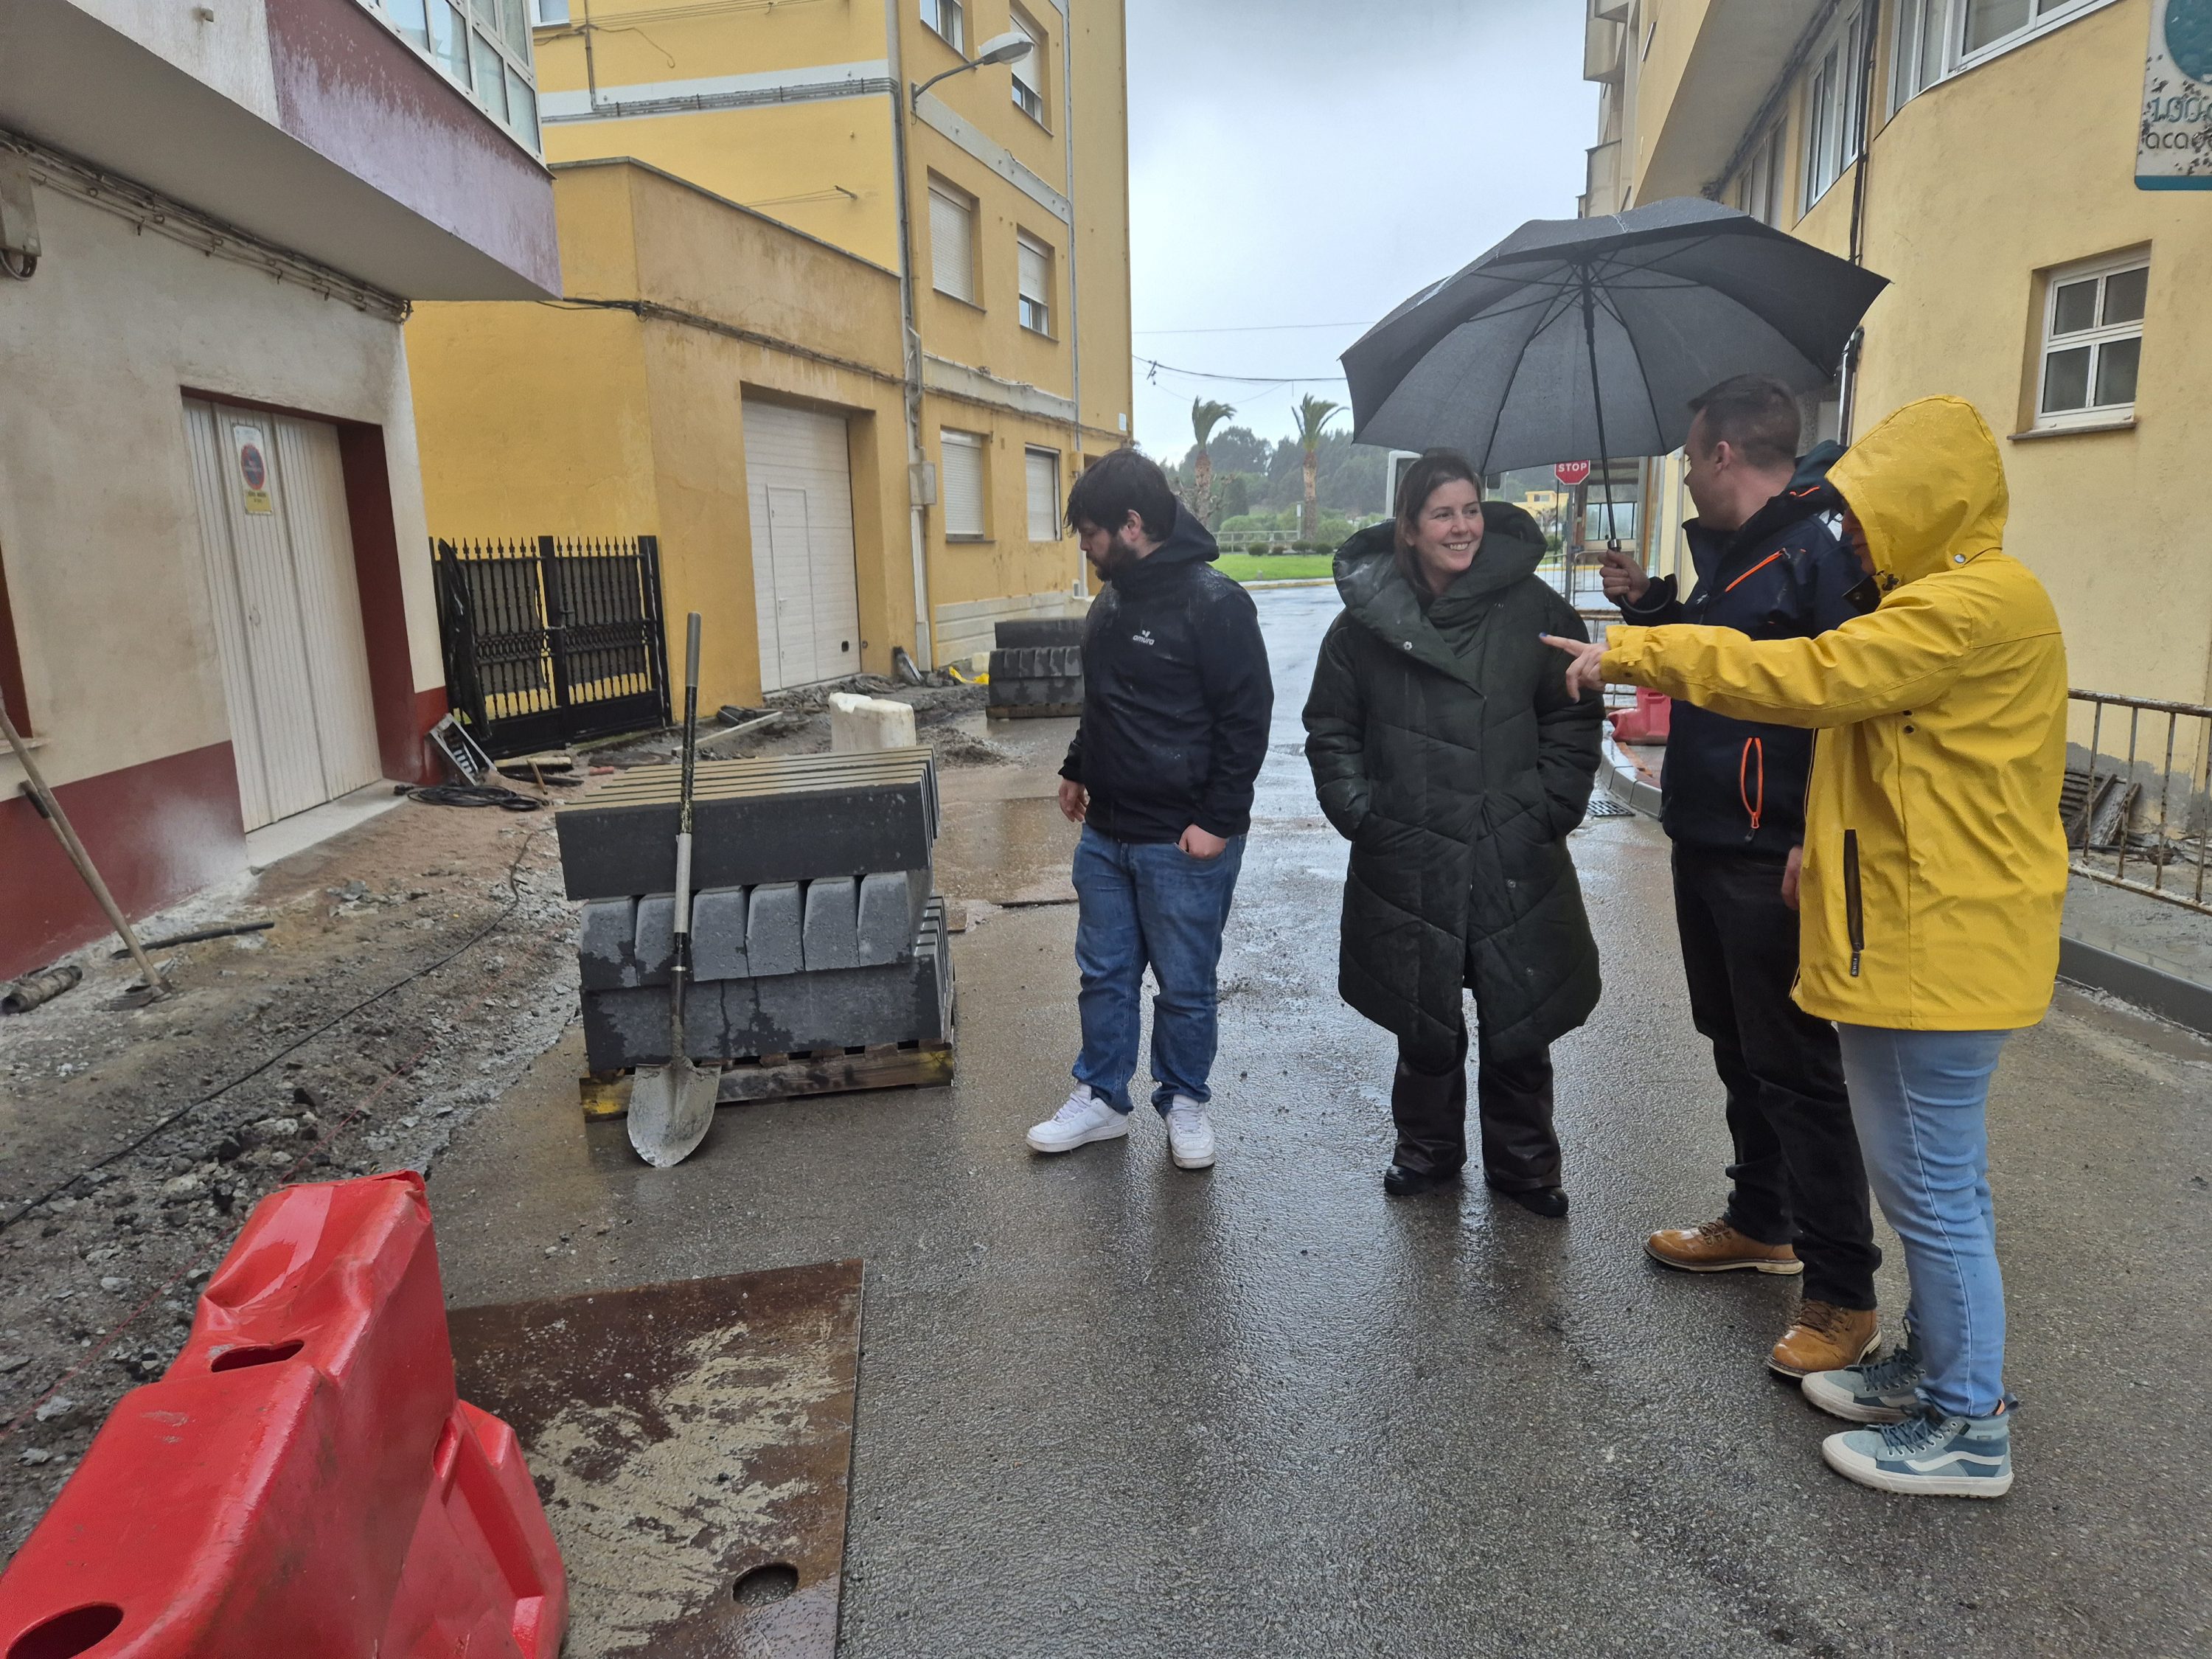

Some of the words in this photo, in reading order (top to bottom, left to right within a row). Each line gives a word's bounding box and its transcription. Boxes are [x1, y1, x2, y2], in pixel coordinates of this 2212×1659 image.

[2145, 132, 2212, 150] aca
[1558, 462, 1587, 473] STOP
[1133, 635, 1155, 646] amura
